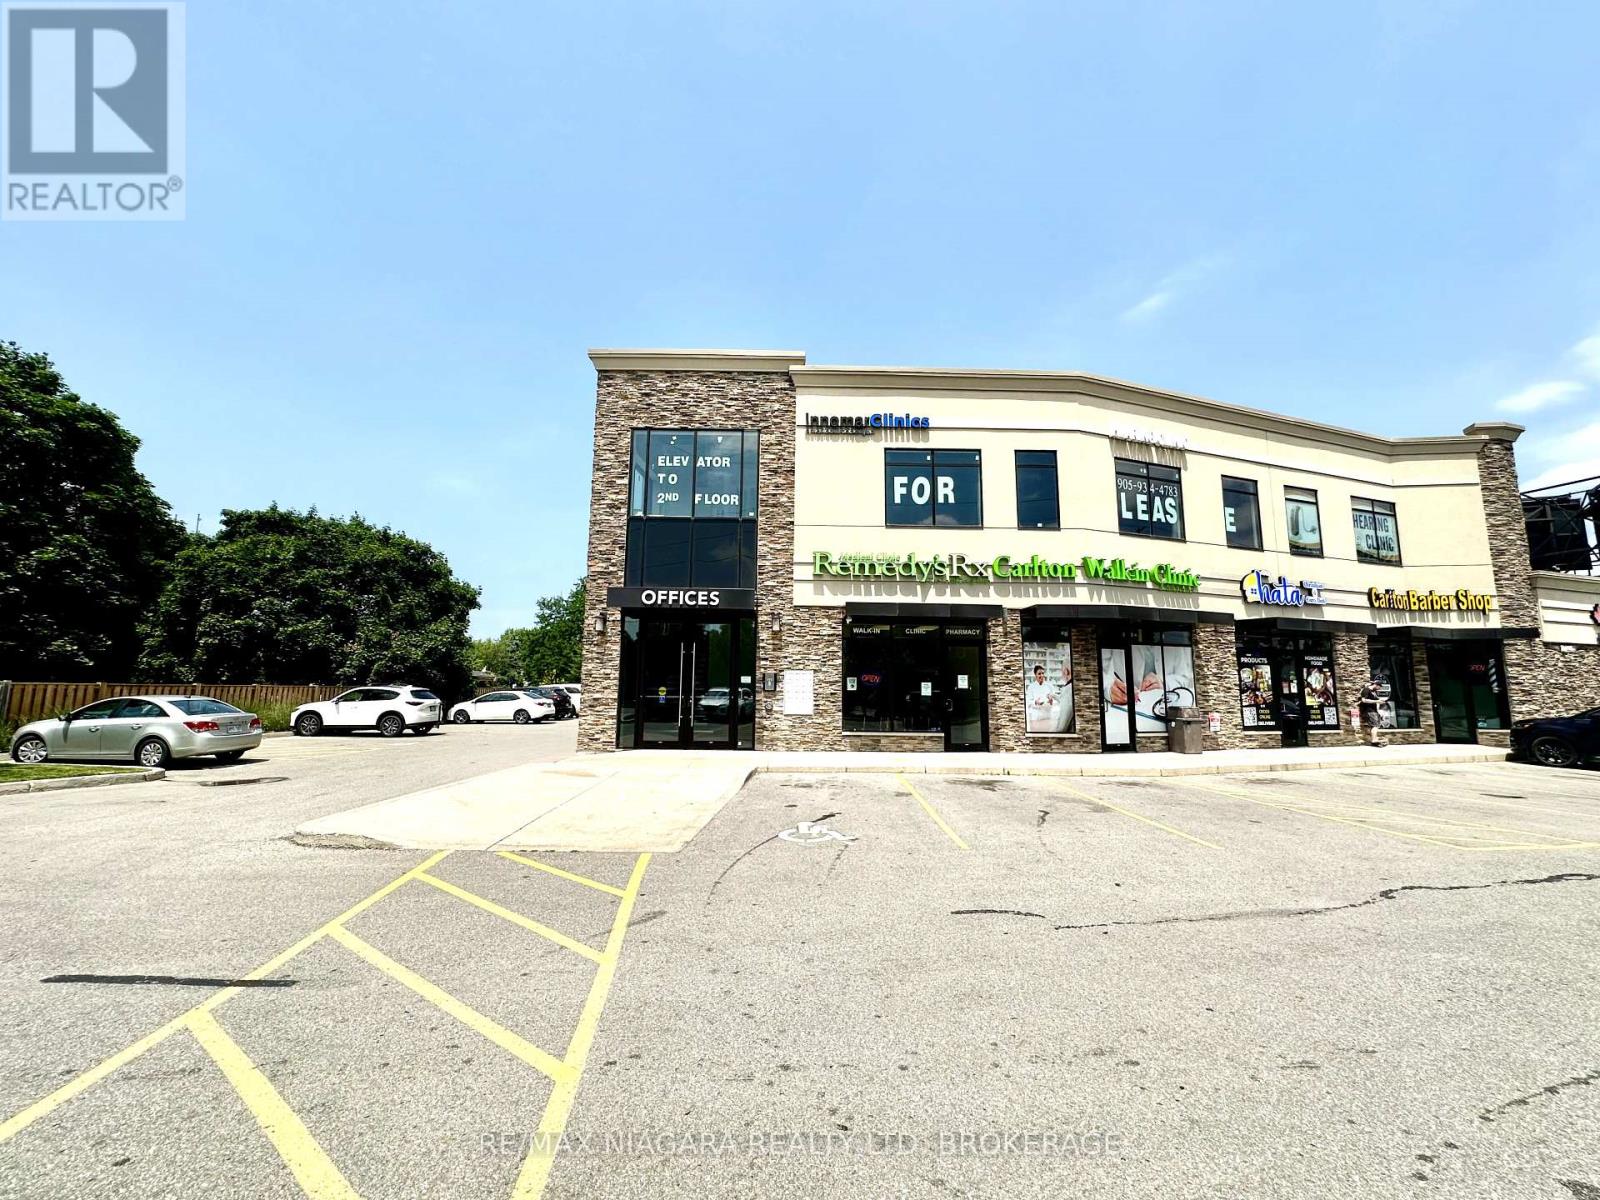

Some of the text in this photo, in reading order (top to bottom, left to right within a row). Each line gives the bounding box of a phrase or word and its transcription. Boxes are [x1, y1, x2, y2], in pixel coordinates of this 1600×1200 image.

[657, 455, 731, 468] ELEVATOR
[657, 473, 678, 485] TO
[1117, 477, 1178, 497] 905-934-4783
[657, 492, 740, 506] 2ND FLOOR
[893, 476, 955, 505] FOR
[1352, 513, 1389, 533] HEARNG
[1365, 534, 1394, 552] CLNIC
[991, 554, 1076, 578] Carlton
[1150, 563, 1201, 587] Clinic
[641, 589, 720, 606] OFFICES
[1407, 590, 1456, 610] Barber
[1456, 589, 1492, 615] Shop
[861, 674, 881, 683] OPEN
